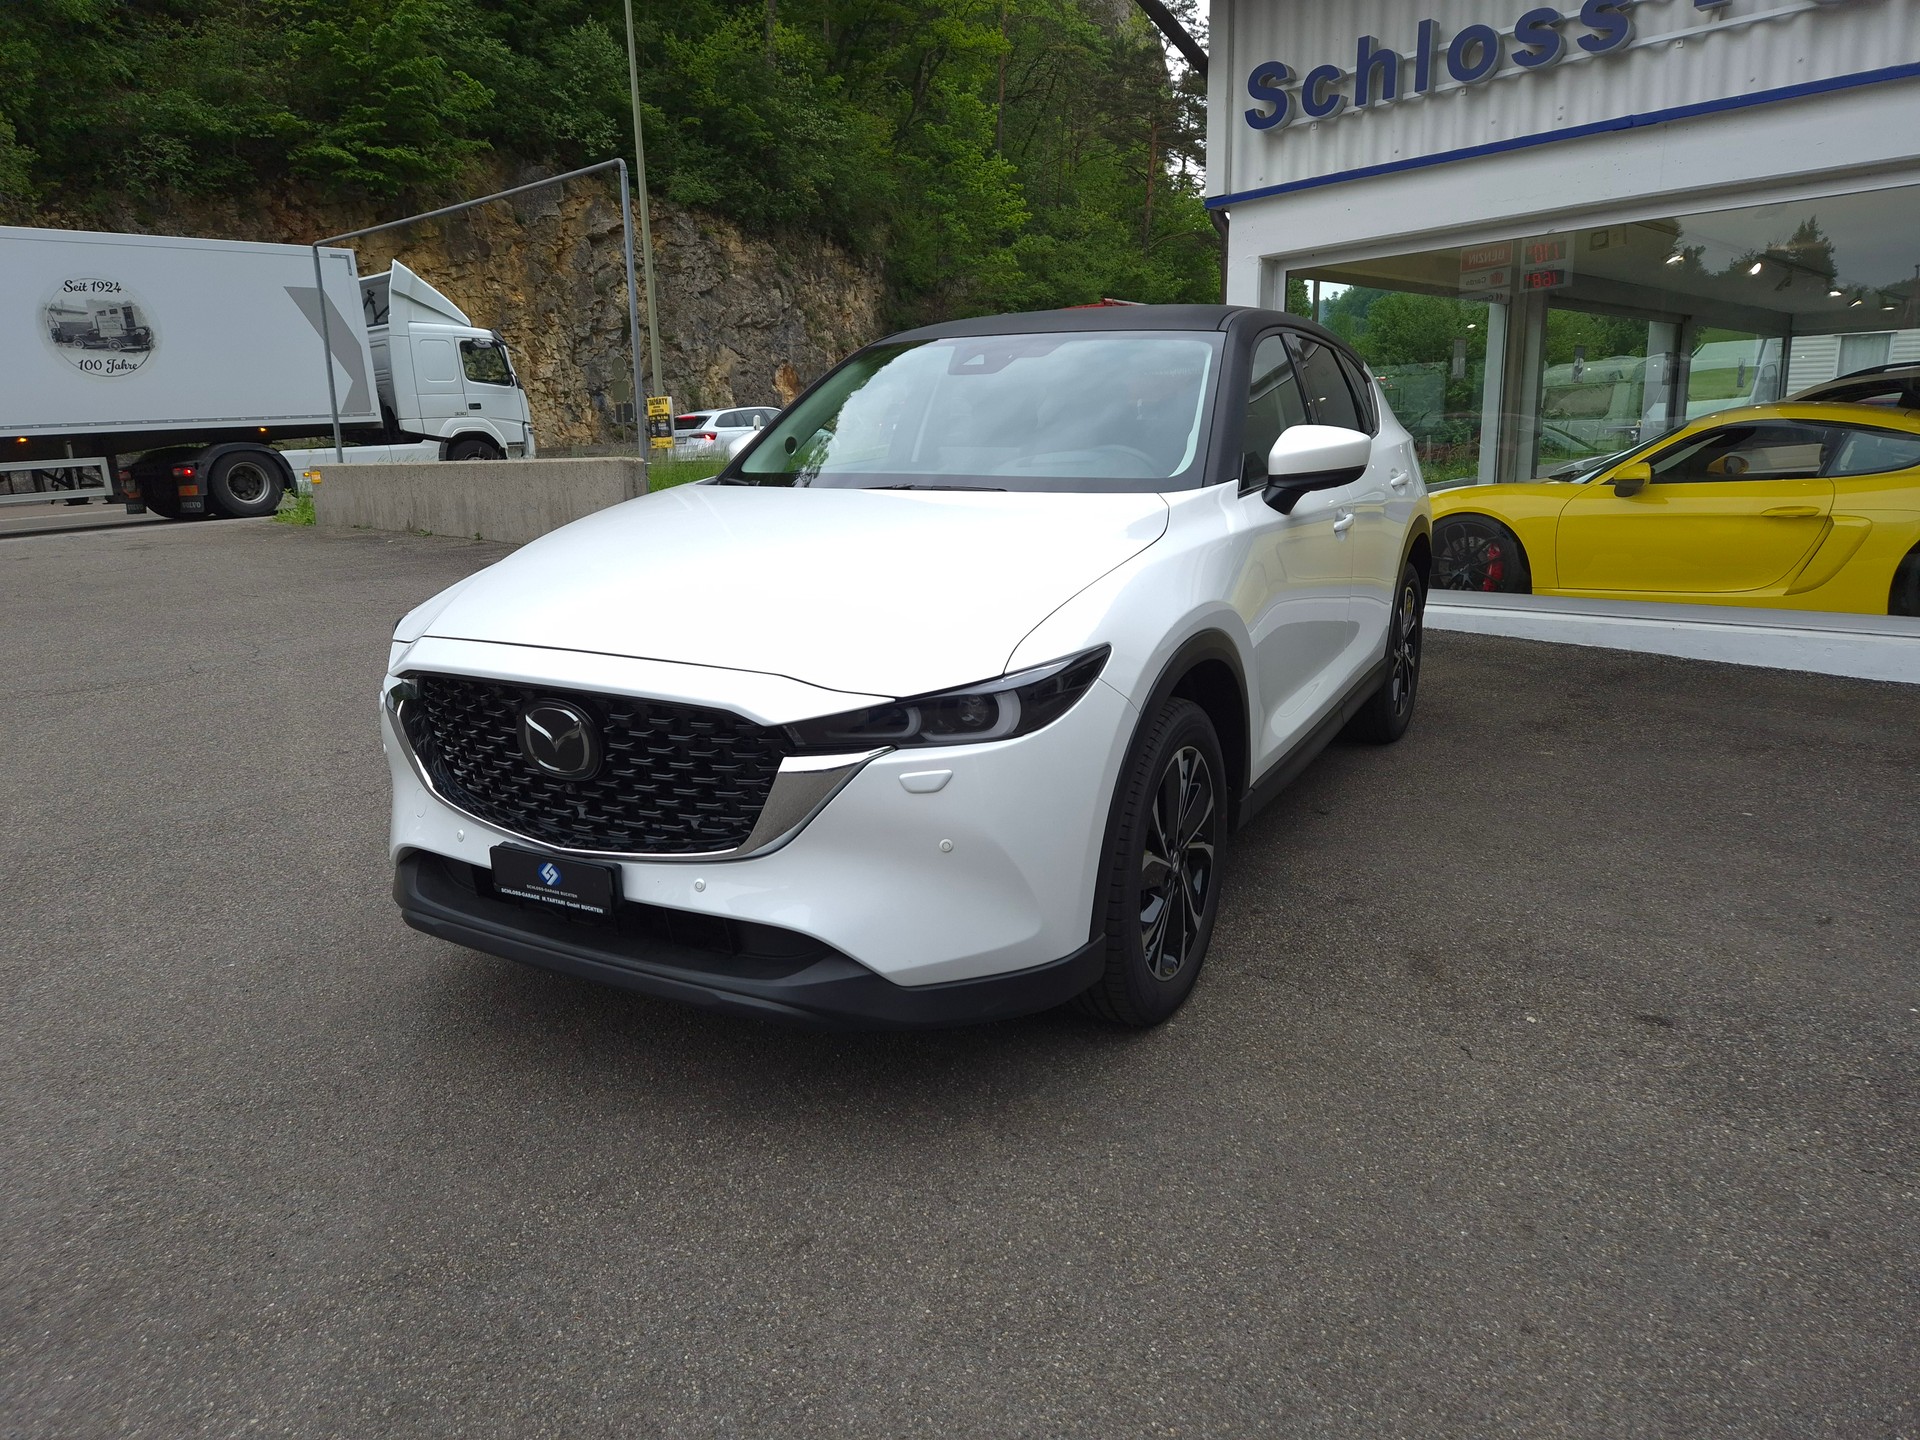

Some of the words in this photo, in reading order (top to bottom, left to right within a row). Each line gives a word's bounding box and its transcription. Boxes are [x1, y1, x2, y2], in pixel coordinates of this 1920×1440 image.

[1245, 0, 1637, 132] Schloss
[63, 280, 88, 293] Seit
[91, 280, 122, 293] 1924
[79, 359, 102, 371] 100
[106, 359, 138, 374] Jahre
[182, 501, 202, 509] VOLVO
[526, 884, 560, 895] SCHLOSS-GARAGE
[501, 887, 540, 900] SCHLOSS-GARAGE
[566, 901, 580, 909] GmbH
[581, 904, 604, 914] BUCKTEN
